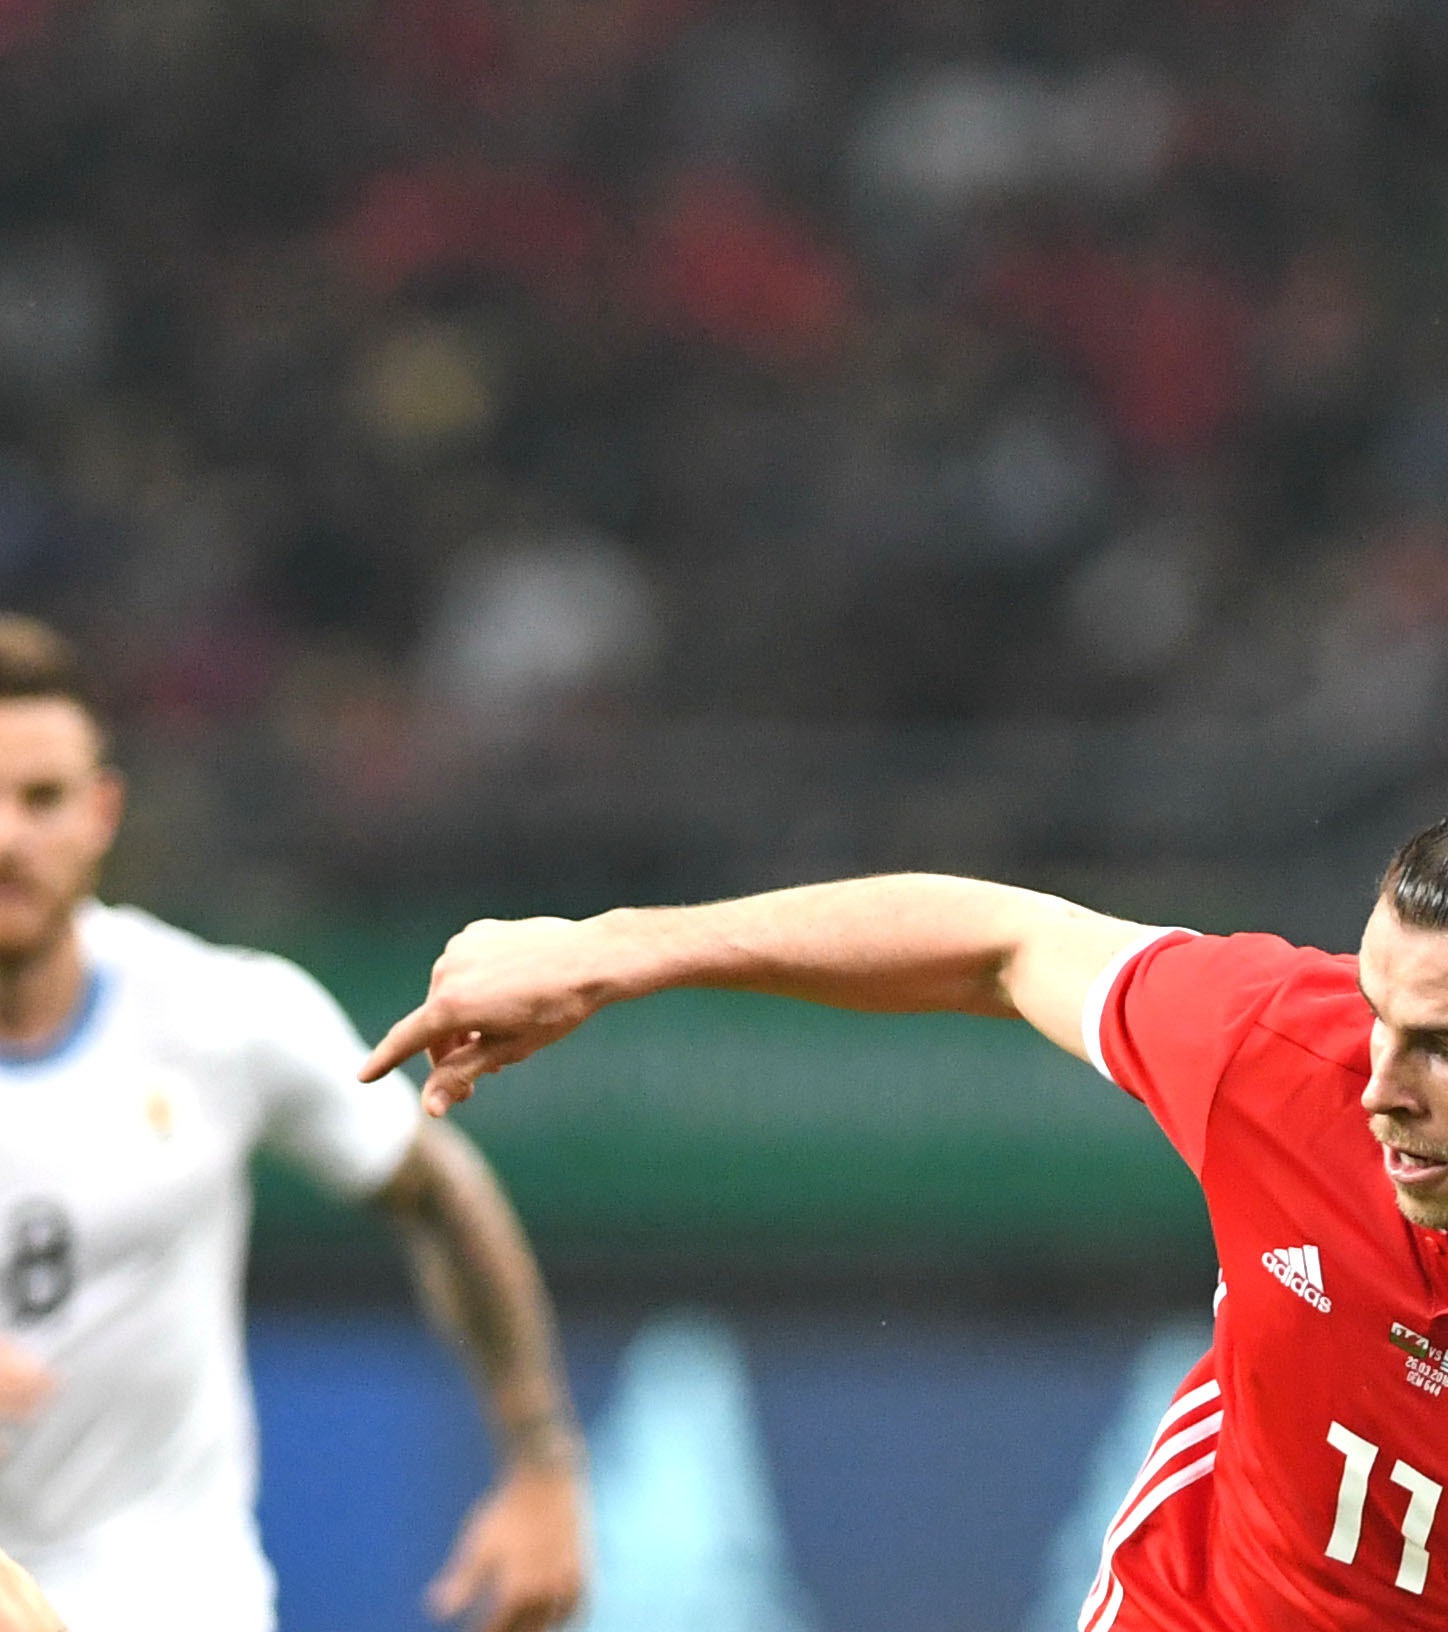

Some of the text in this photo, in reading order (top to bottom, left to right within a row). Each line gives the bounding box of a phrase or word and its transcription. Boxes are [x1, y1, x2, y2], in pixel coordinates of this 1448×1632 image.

[3, 1198, 75, 1321] 8
[1261, 1251, 1332, 1314] adidas
[1325, 1420, 1443, 1595] 11
